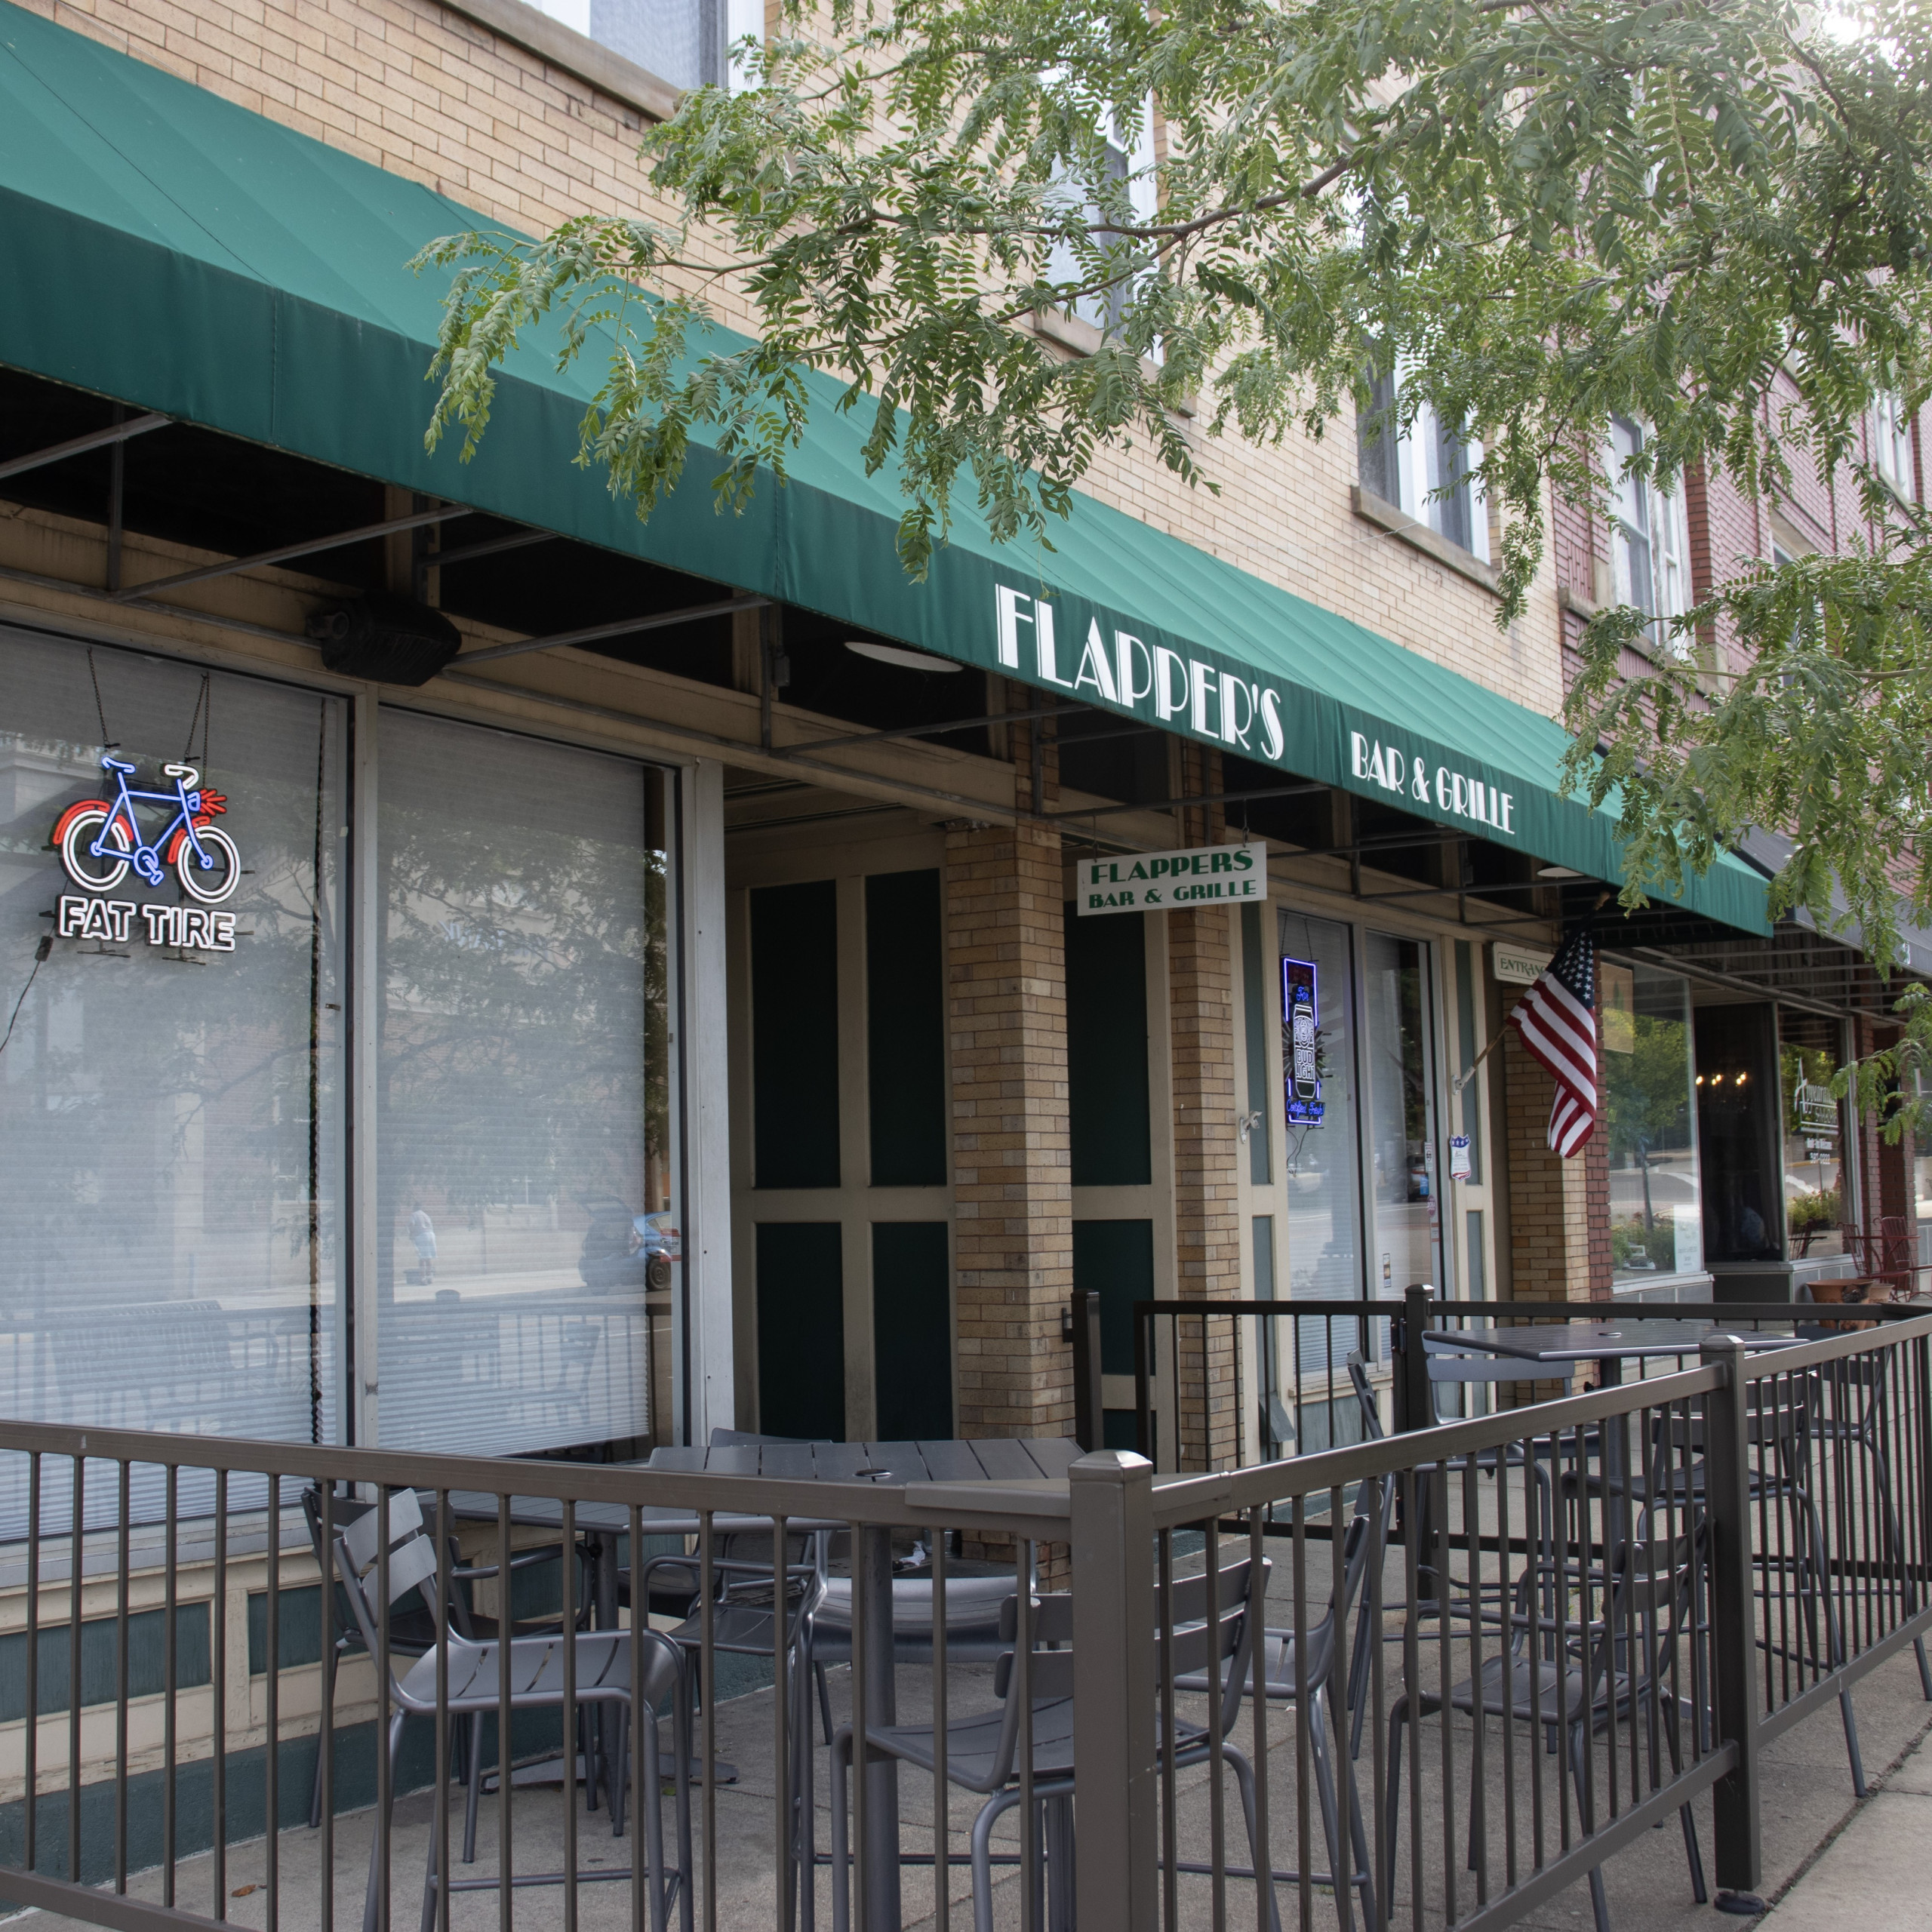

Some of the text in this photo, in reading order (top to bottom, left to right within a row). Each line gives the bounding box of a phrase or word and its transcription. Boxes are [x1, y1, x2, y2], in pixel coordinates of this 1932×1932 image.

[995, 583, 1284, 761] FLAPPER'S
[1351, 731, 1515, 835] BAR & GRILLE
[1091, 850, 1254, 884] FLAPPERS
[1088, 879, 1257, 909] BAR & GRILLE
[59, 895, 236, 952] FAT TIRE
[1500, 957, 1546, 977] ENTRANC
[1296, 1048, 1314, 1065] BUD
[1296, 1064, 1315, 1080] LIGHT
